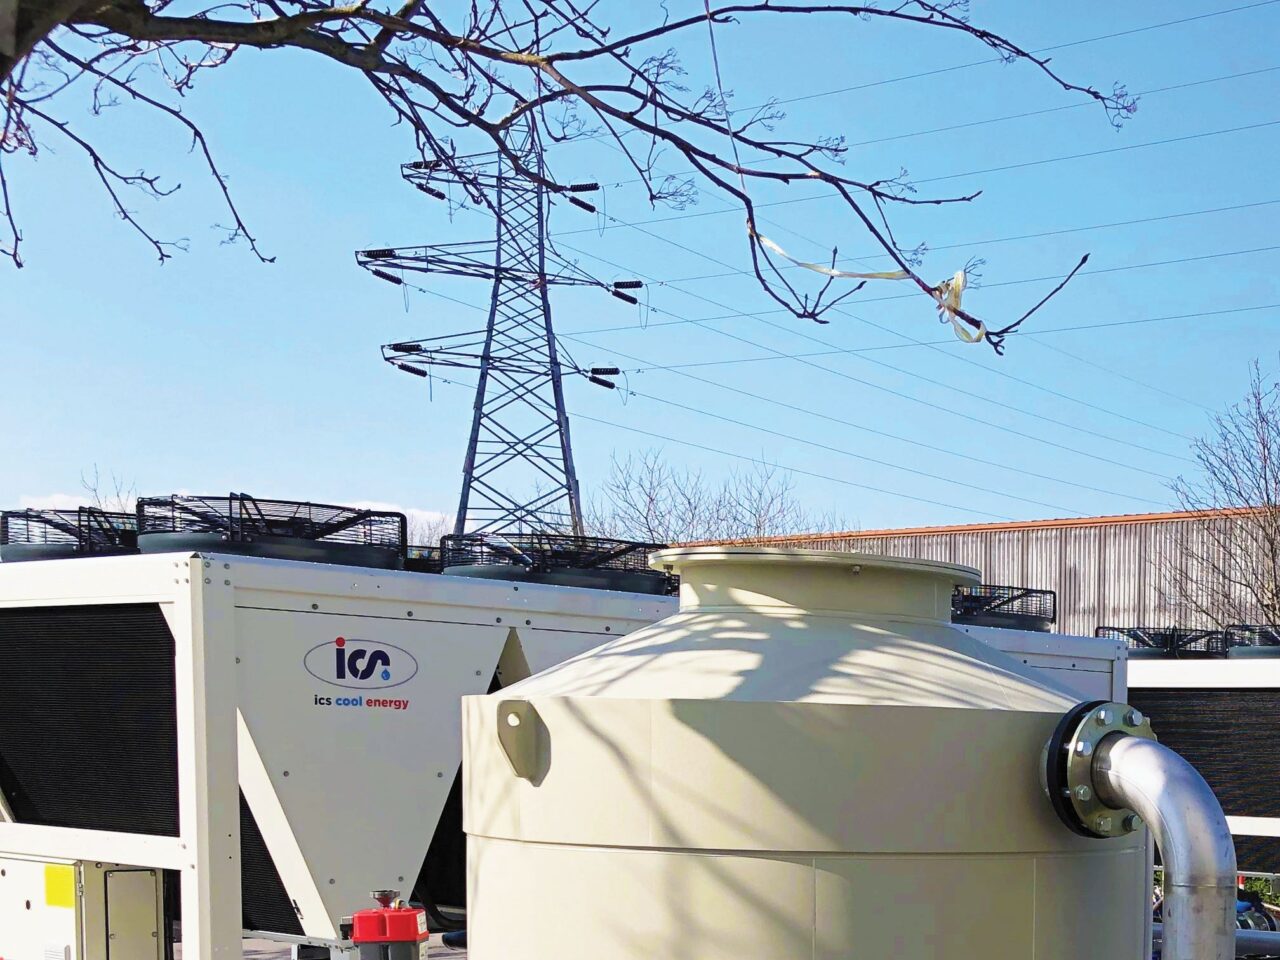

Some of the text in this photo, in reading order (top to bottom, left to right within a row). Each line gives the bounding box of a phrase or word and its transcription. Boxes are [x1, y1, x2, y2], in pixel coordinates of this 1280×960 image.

[335, 637, 391, 680] ics
[314, 694, 409, 710] ics cool energy
